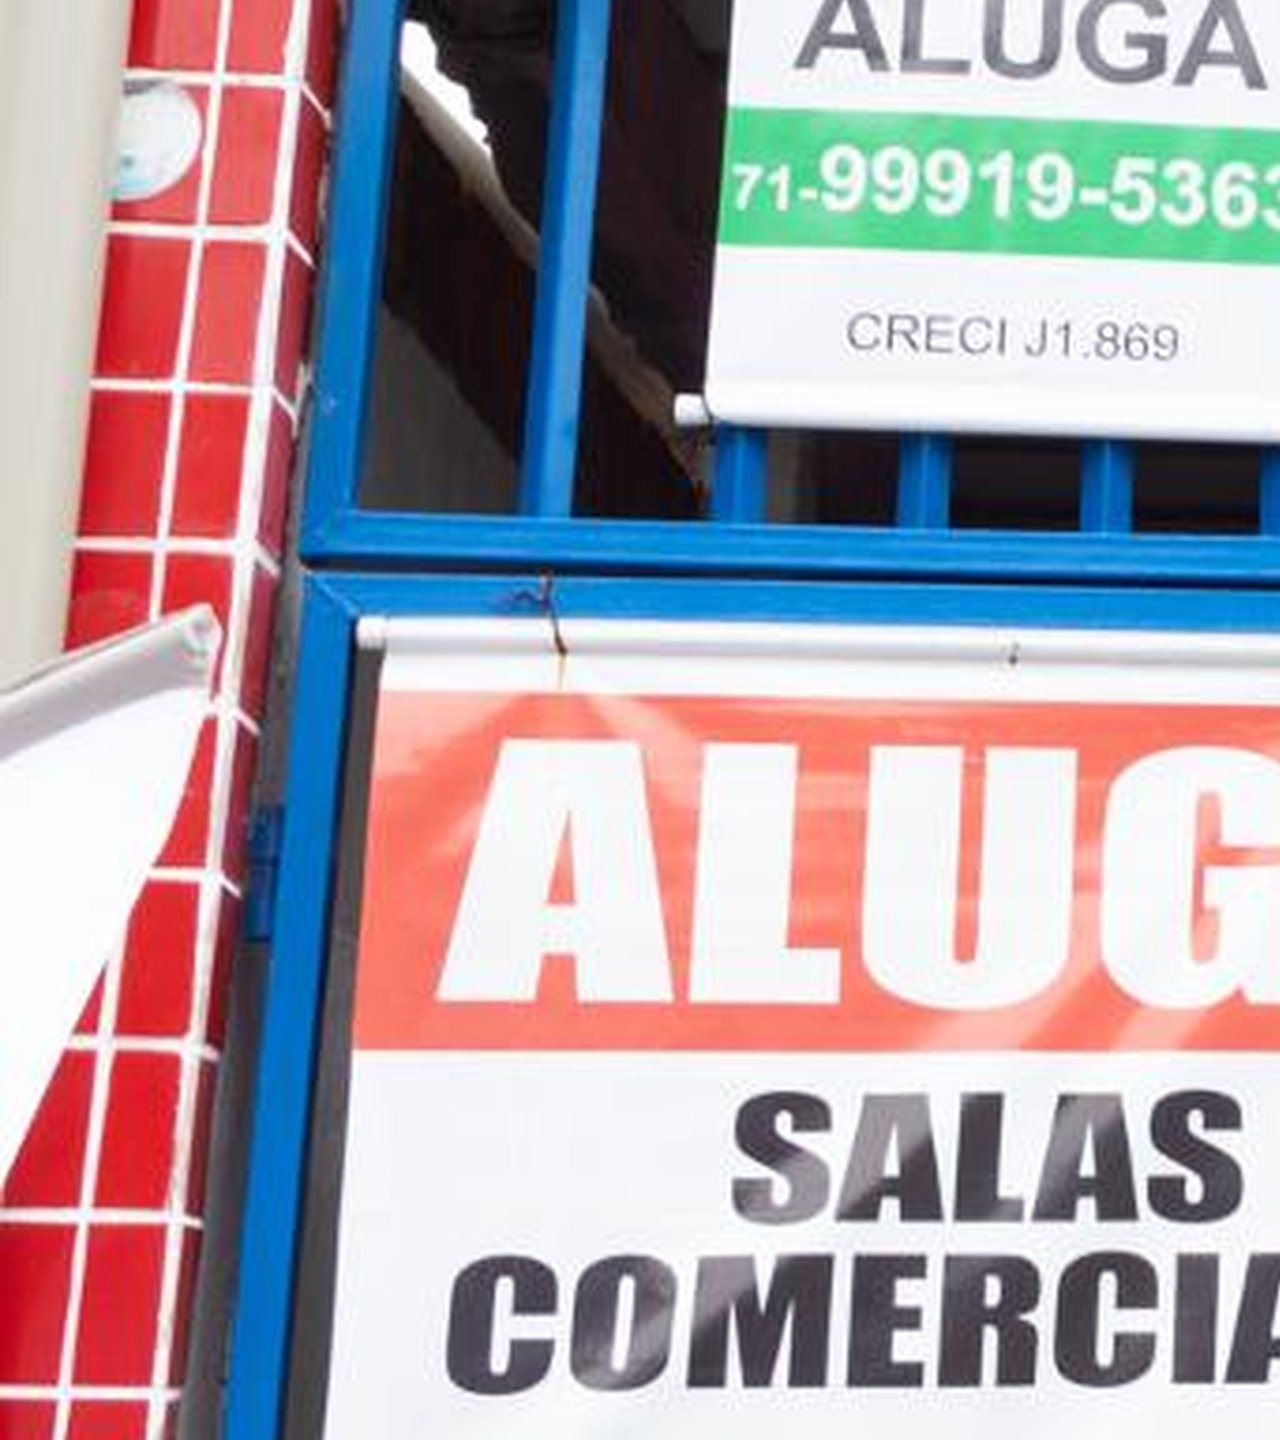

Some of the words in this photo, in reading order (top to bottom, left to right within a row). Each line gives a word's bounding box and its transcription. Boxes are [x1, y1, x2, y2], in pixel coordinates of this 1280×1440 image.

[846, 310, 1007, 356] CRECI
[1024, 318, 1180, 362] J1.869
[730, 1087, 1245, 1227] SALAS
